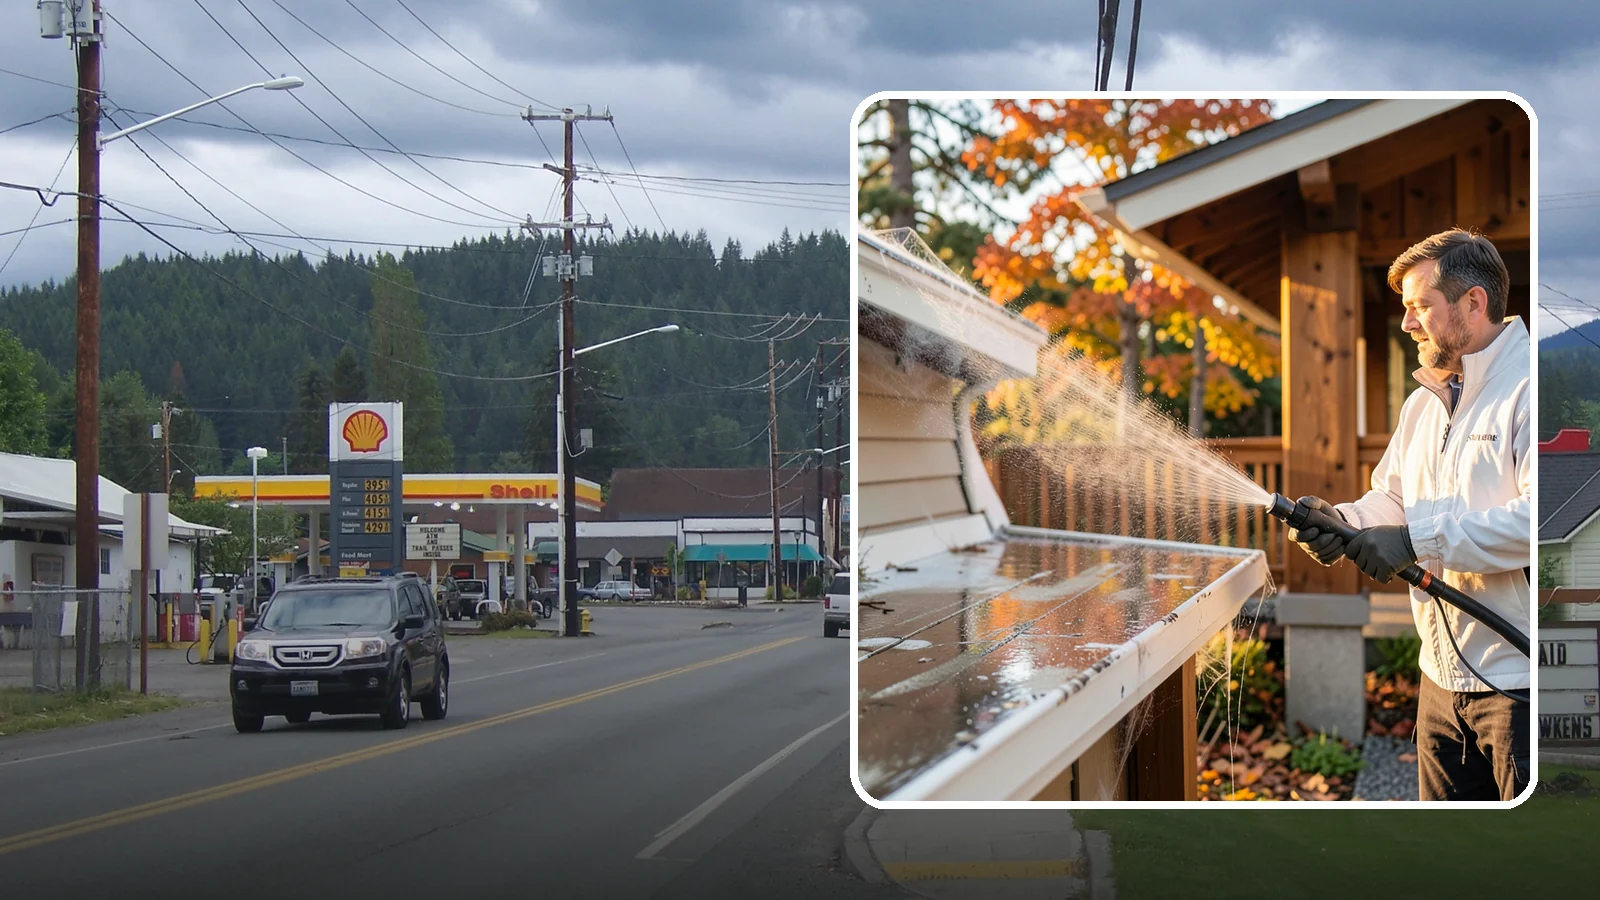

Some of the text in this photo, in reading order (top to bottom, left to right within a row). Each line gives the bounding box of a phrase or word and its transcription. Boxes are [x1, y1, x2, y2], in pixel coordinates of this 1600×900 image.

[366, 480, 384, 490] 395
[490, 484, 547, 499] Shell
[366, 494, 384, 504] 405
[366, 508, 384, 518] 415
[366, 522, 384, 533] 429
